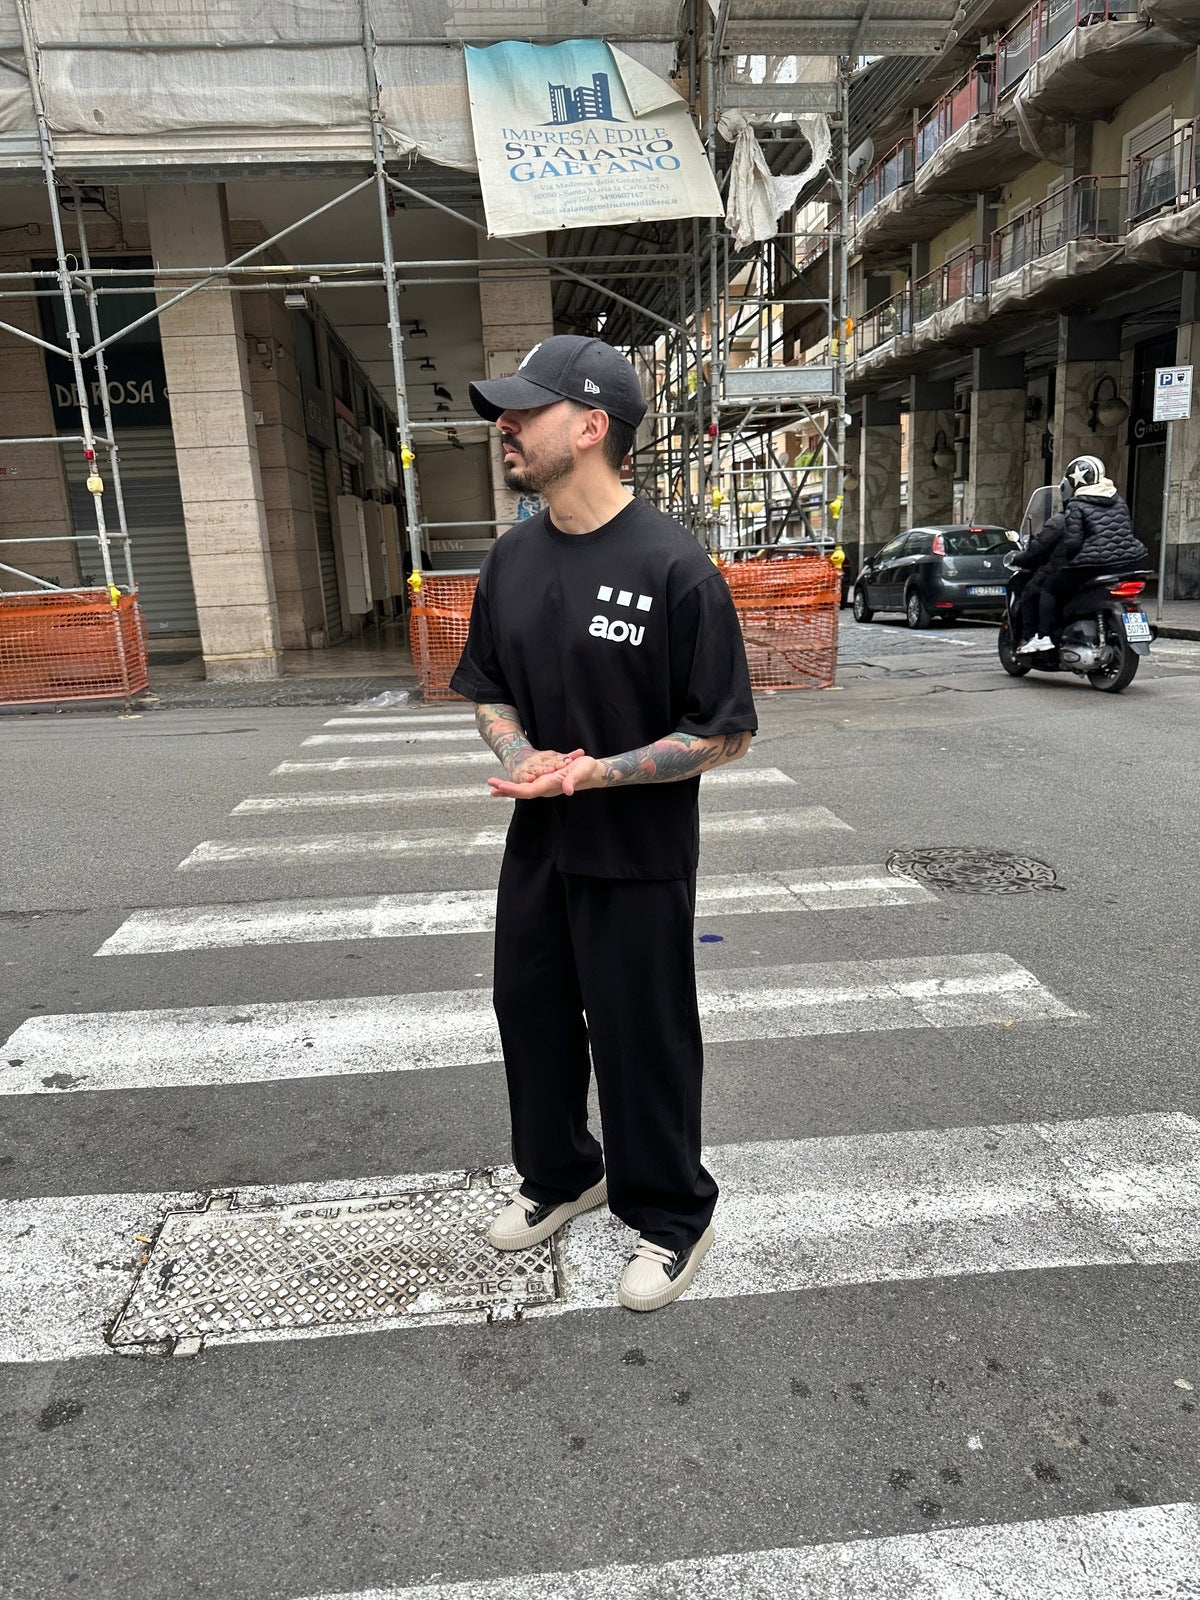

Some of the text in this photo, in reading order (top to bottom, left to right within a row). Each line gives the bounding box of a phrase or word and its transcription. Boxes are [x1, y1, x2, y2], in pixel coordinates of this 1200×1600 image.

[502, 127, 669, 145] IMPRESA EDILE
[504, 139, 674, 161] STAIANO
[509, 154, 681, 182] GAETANO
[555, 181, 593, 189] Madonna
[563, 189, 586, 197] Santa
[649, 183, 670, 191] (NA)
[1163, 375, 1171, 385] P
[292, 1200, 406, 1220] open fiber
